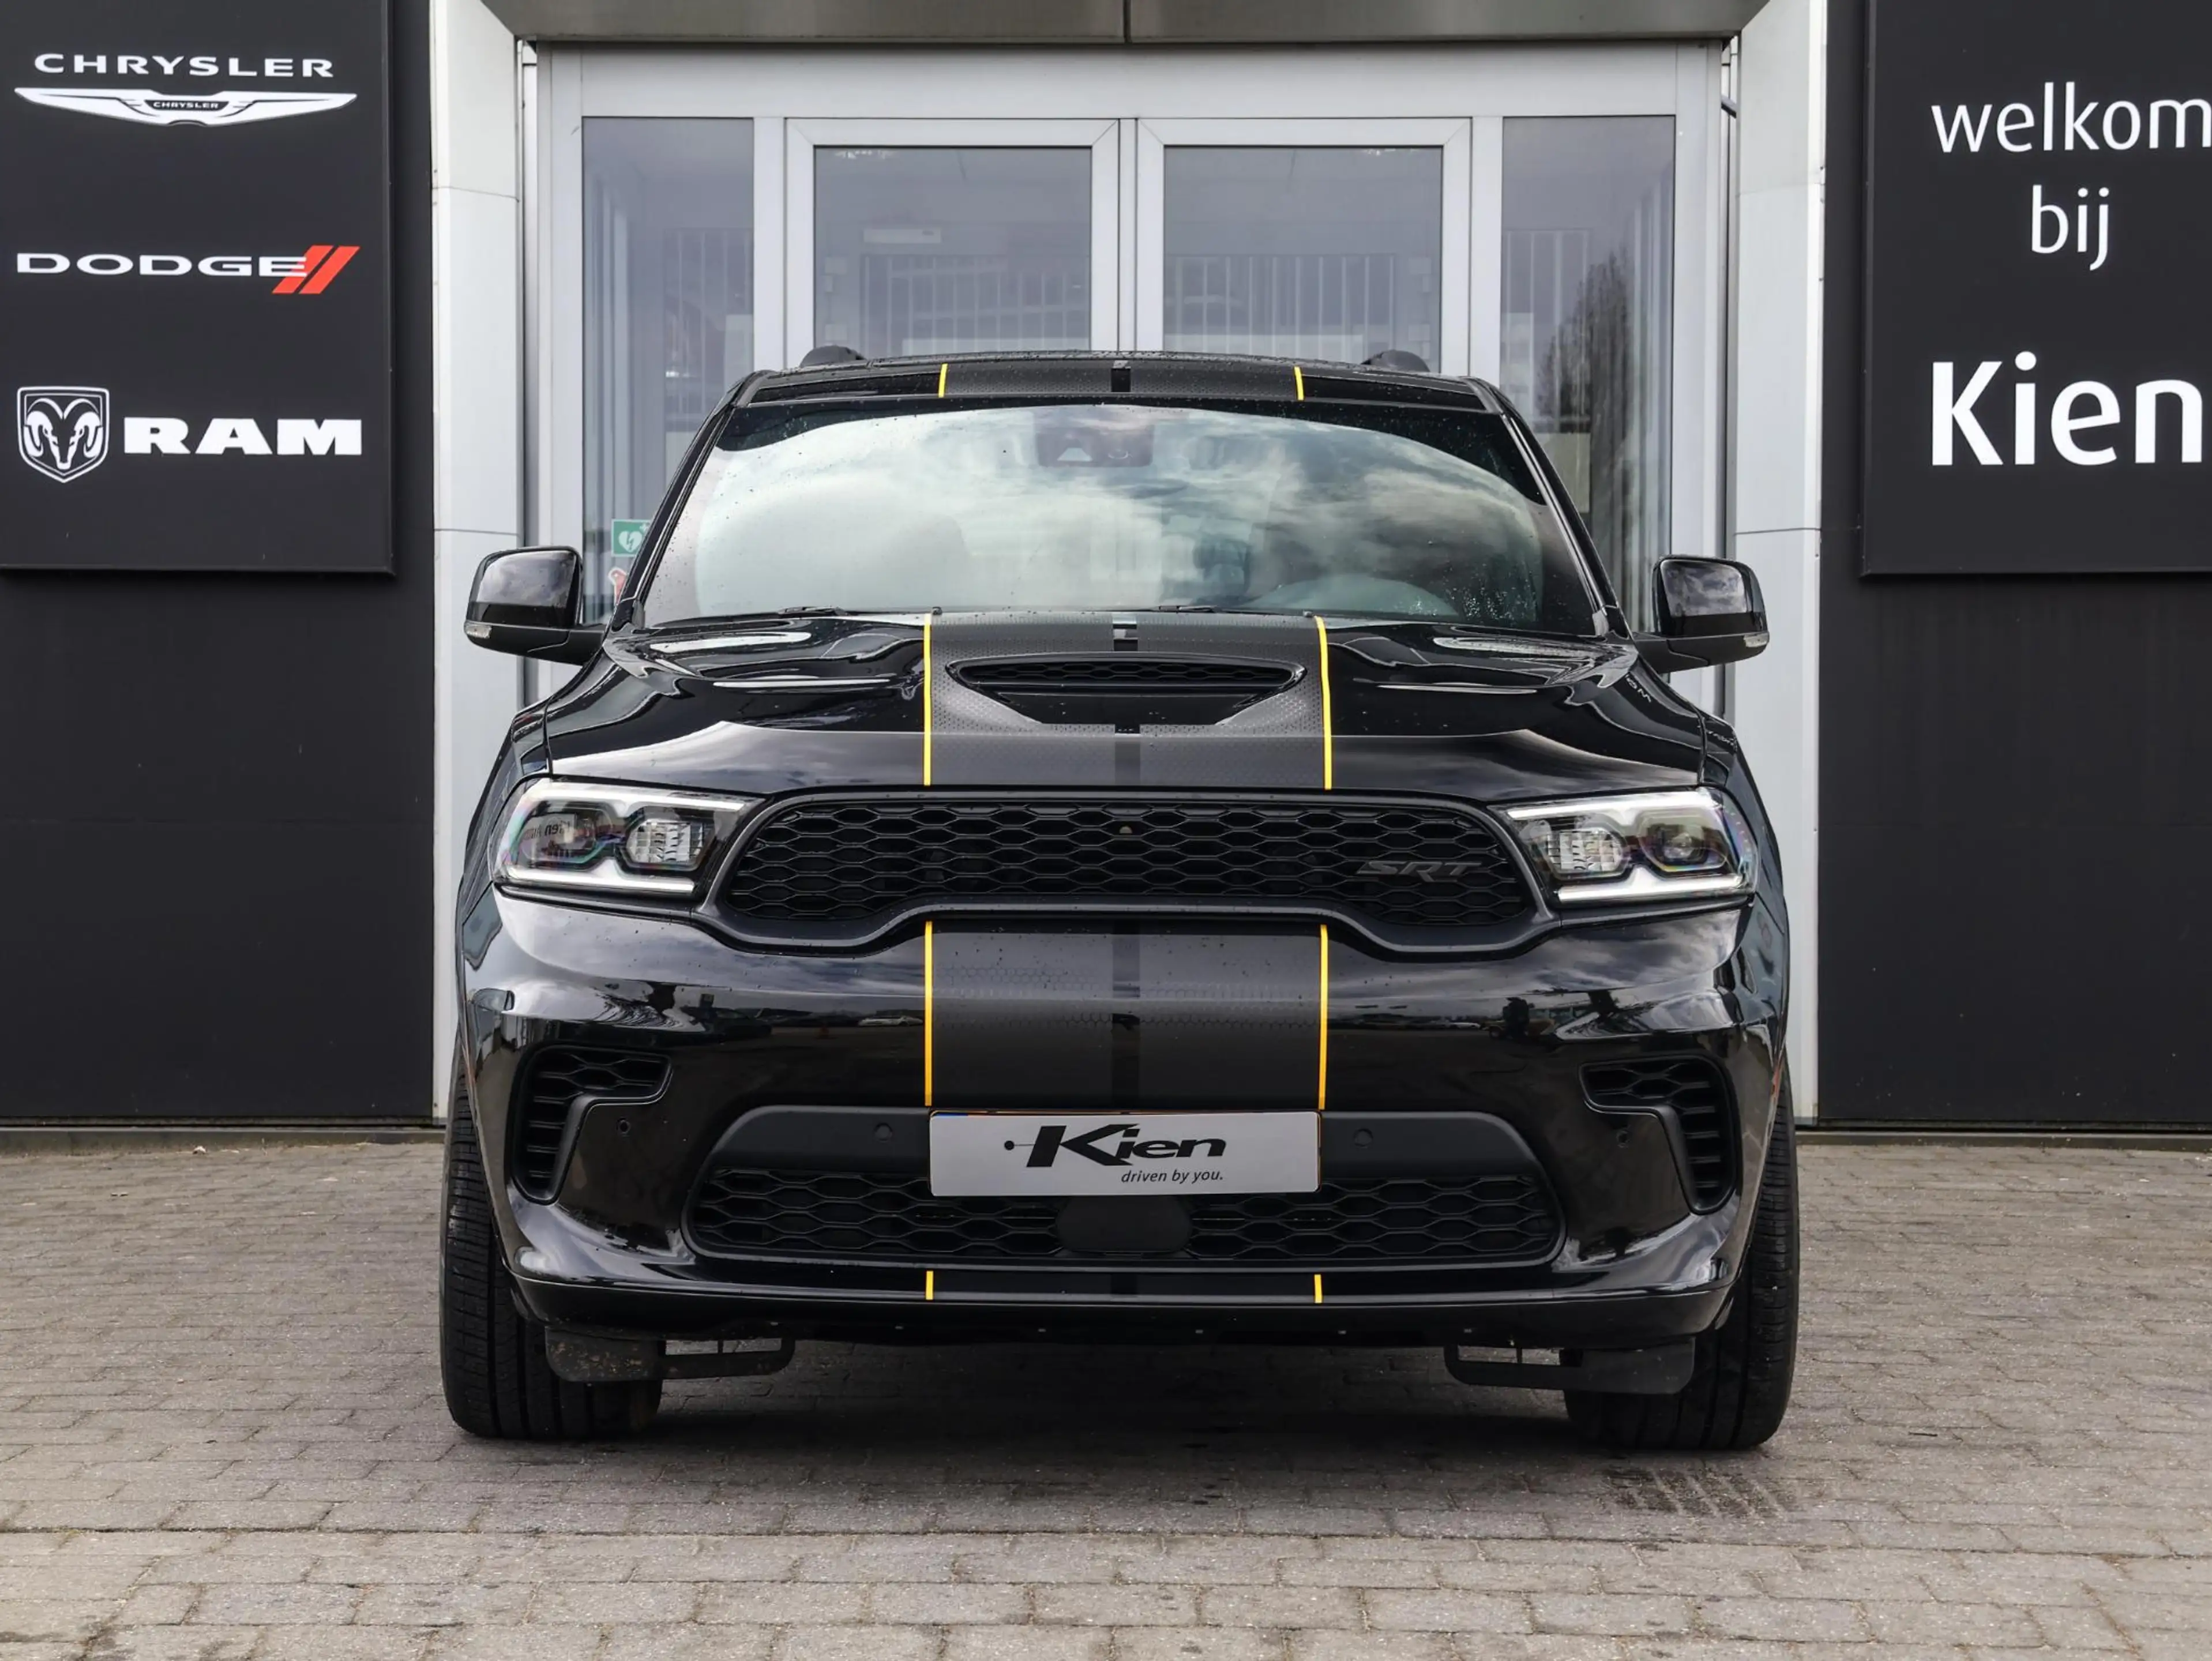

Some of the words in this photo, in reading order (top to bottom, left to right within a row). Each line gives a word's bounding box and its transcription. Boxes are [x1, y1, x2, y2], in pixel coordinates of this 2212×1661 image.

[35, 53, 333, 77] CHRYSLER
[153, 101, 219, 109] CHRYSLER
[1931, 81, 2212, 153] welkom
[2031, 185, 2109, 271] bij
[17, 253, 307, 277] DODGE
[1932, 351, 2203, 466] Kien
[123, 416, 362, 456] RAM
[1357, 860, 1482, 882] SRT
[1026, 1123, 1226, 1167] Kien
[1121, 1170, 1167, 1183] driven
[1171, 1169, 1190, 1185] by
[1191, 1171, 1223, 1184] you.
